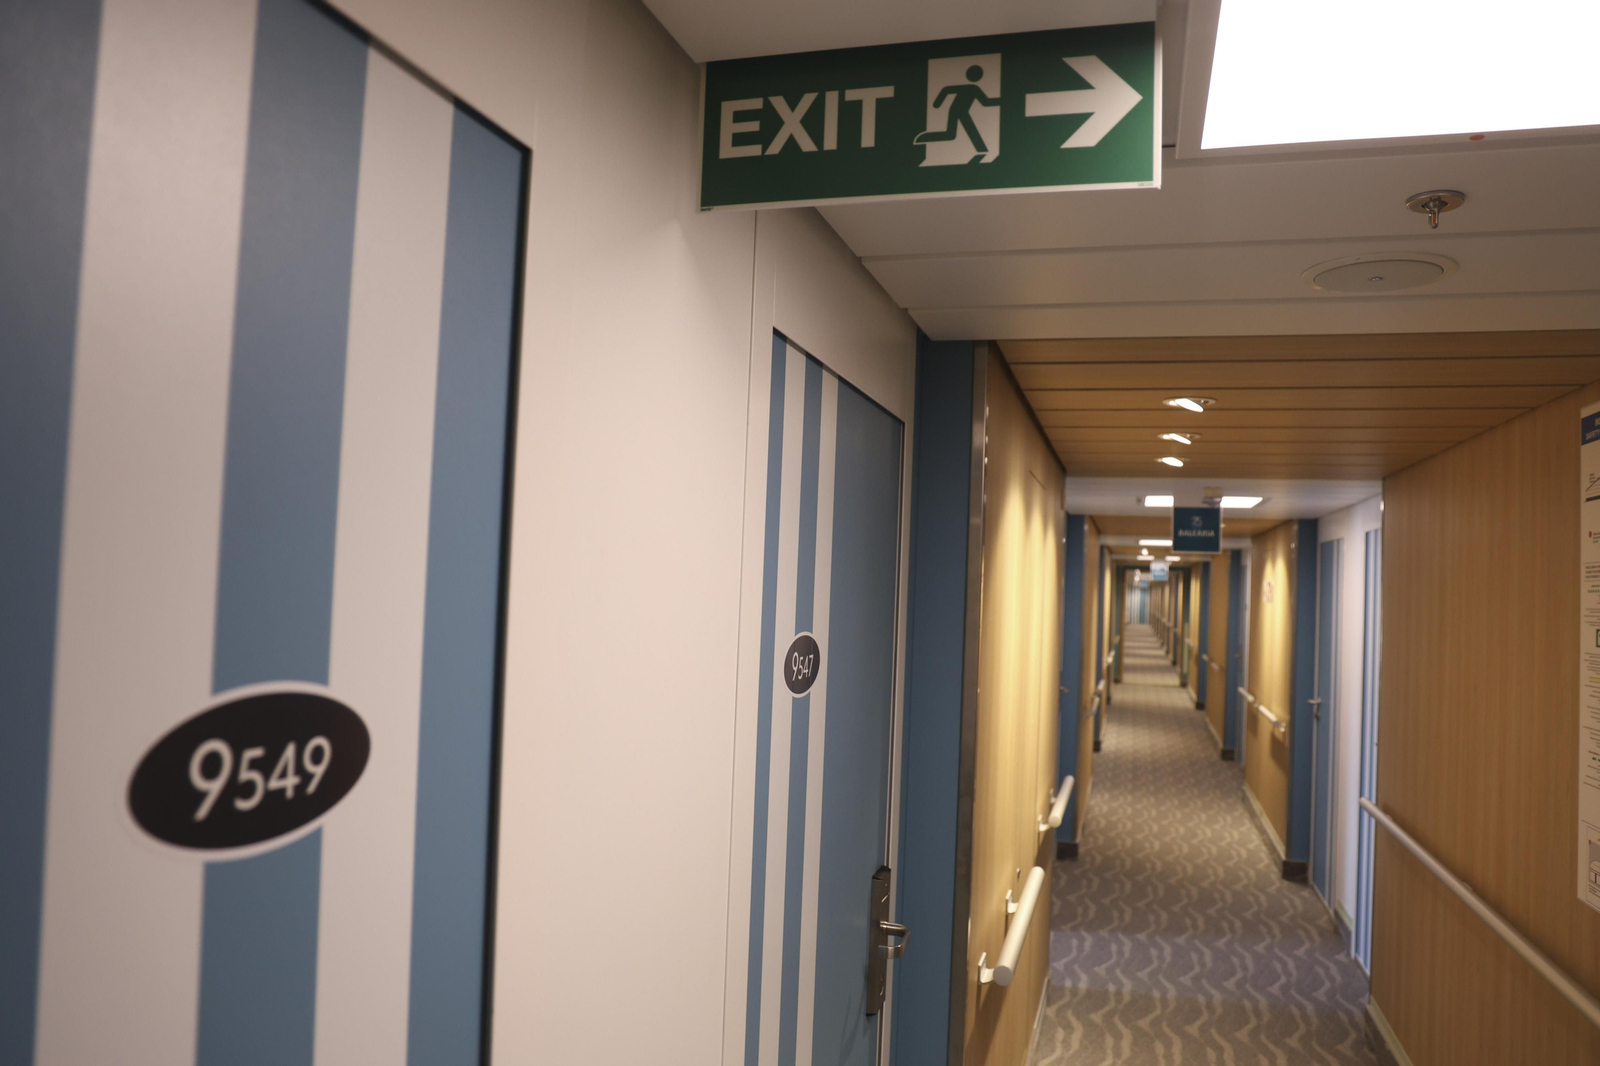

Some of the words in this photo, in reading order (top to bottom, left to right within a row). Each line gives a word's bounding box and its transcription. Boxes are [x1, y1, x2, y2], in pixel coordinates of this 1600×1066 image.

[718, 85, 895, 159] EXIT
[792, 651, 814, 681] 9547
[188, 735, 333, 822] 9549
